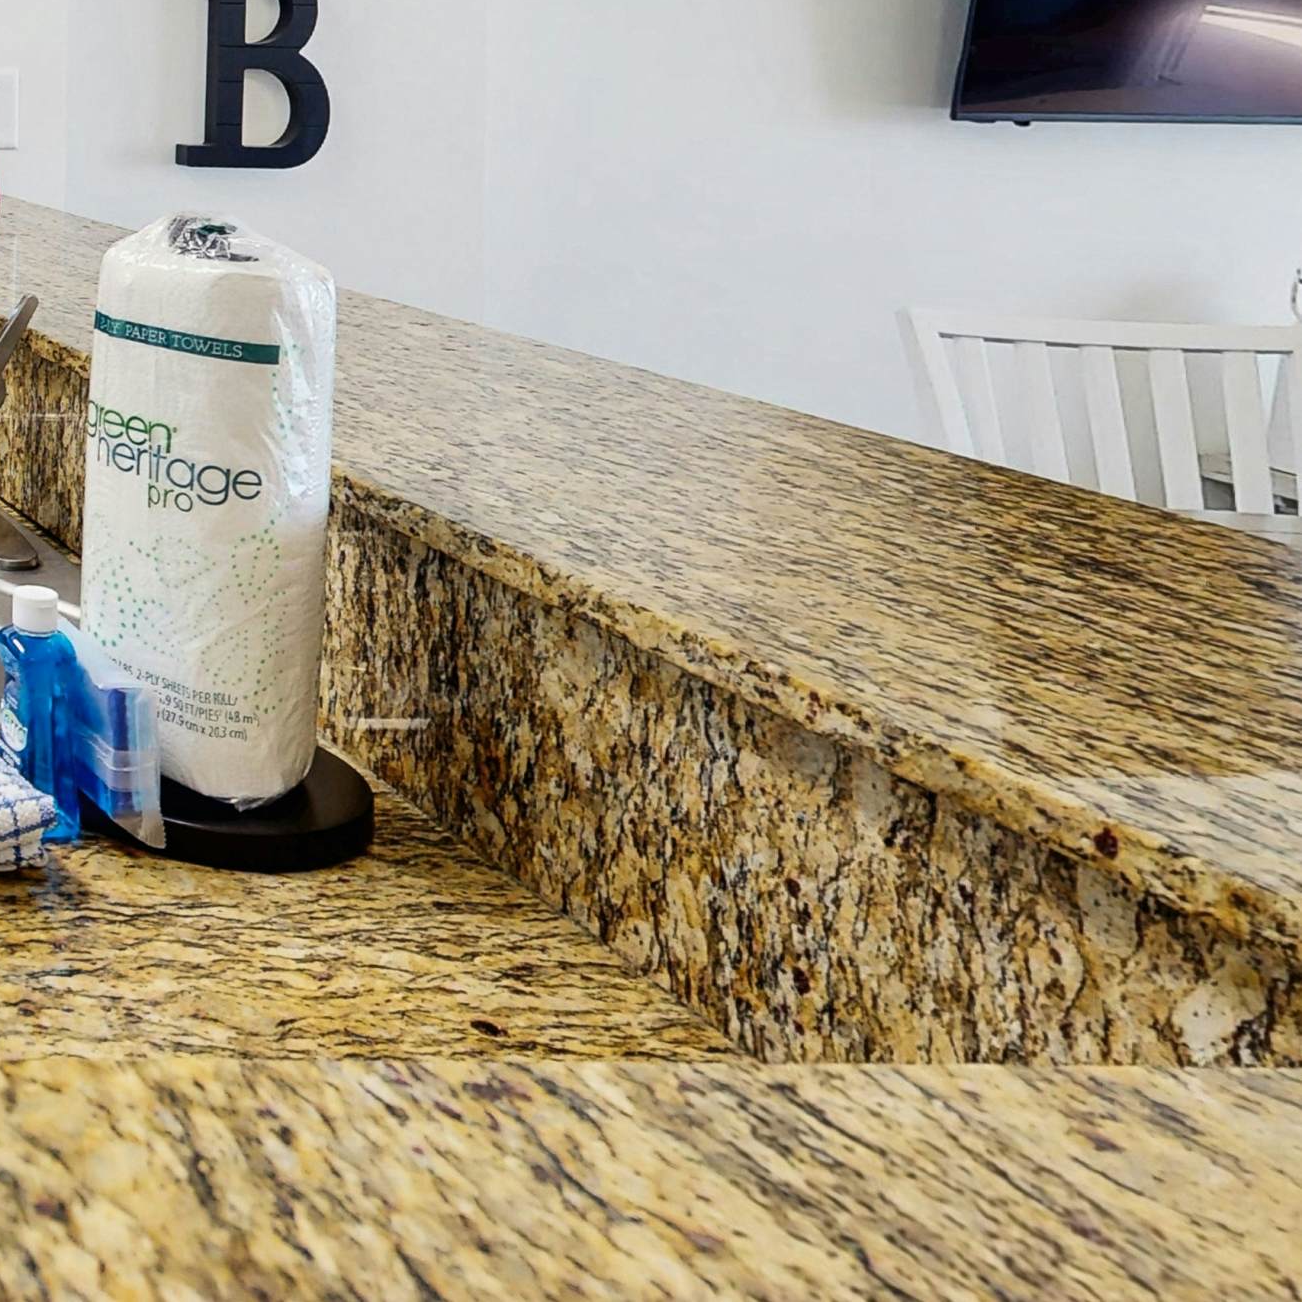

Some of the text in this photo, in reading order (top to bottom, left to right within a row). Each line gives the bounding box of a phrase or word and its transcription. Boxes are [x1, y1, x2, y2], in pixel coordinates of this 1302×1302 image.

[125, 323, 168, 346] PAPER
[171, 333, 243, 359] TOWELS
[98, 428, 263, 506] heritage
[148, 482, 194, 513] pro
[162, 677, 190, 699] SHEETS
[192, 689, 211, 705] PER
[185, 719, 199, 732] cm
[229, 728, 248, 742] cm)
